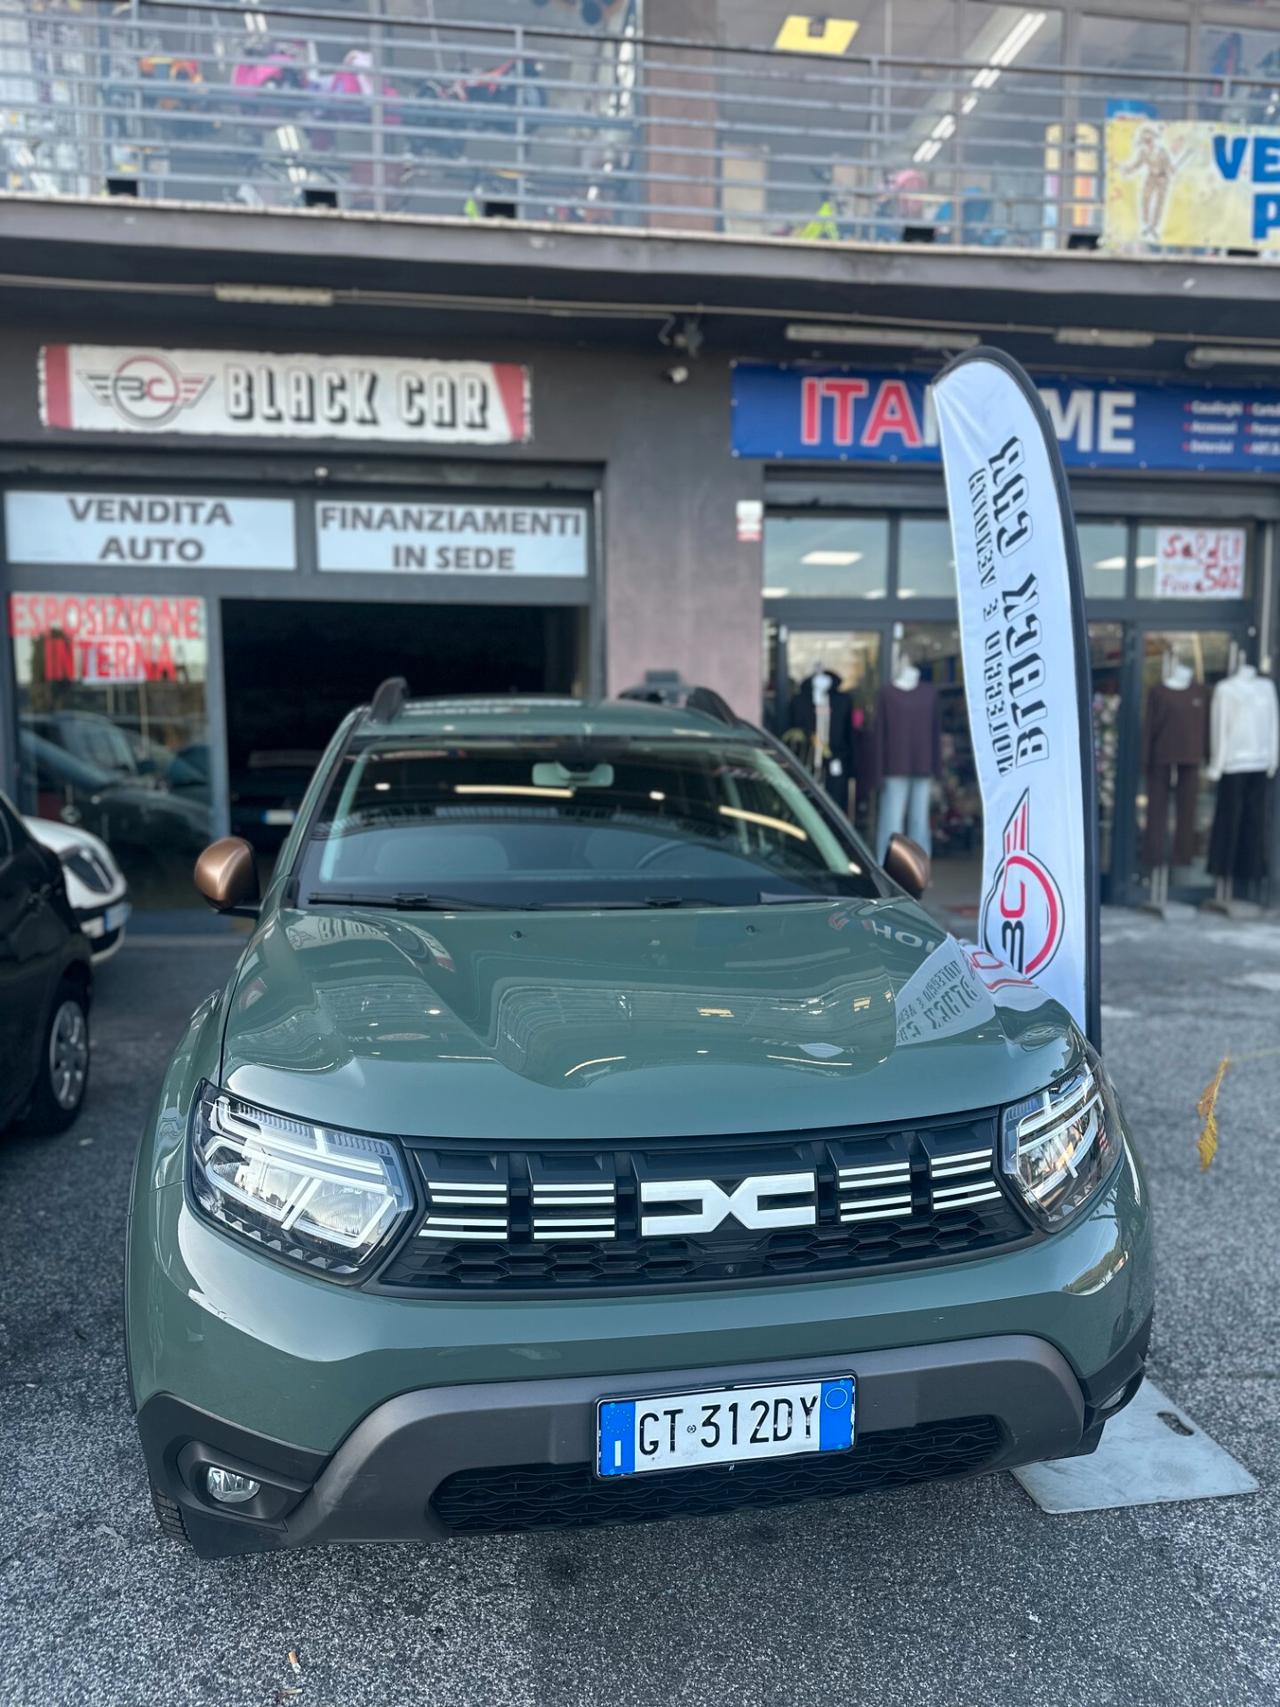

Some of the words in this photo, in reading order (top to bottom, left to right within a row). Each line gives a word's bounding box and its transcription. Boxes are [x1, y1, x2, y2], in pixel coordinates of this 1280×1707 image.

[225, 364, 379, 426] BLACK
[400, 370, 488, 429] CAR
[68, 498, 233, 526] VENDITA
[320, 506, 582, 536] FINANZIAMENTI
[99, 536, 204, 562] AUTO
[392, 544, 427, 569] IN
[434, 546, 516, 571] SEDE
[9, 594, 201, 640] ESPOSIZIONE
[45, 638, 178, 682] INTERNA
[639, 1408, 684, 1456] GT
[700, 1394, 819, 1449] 312DY
